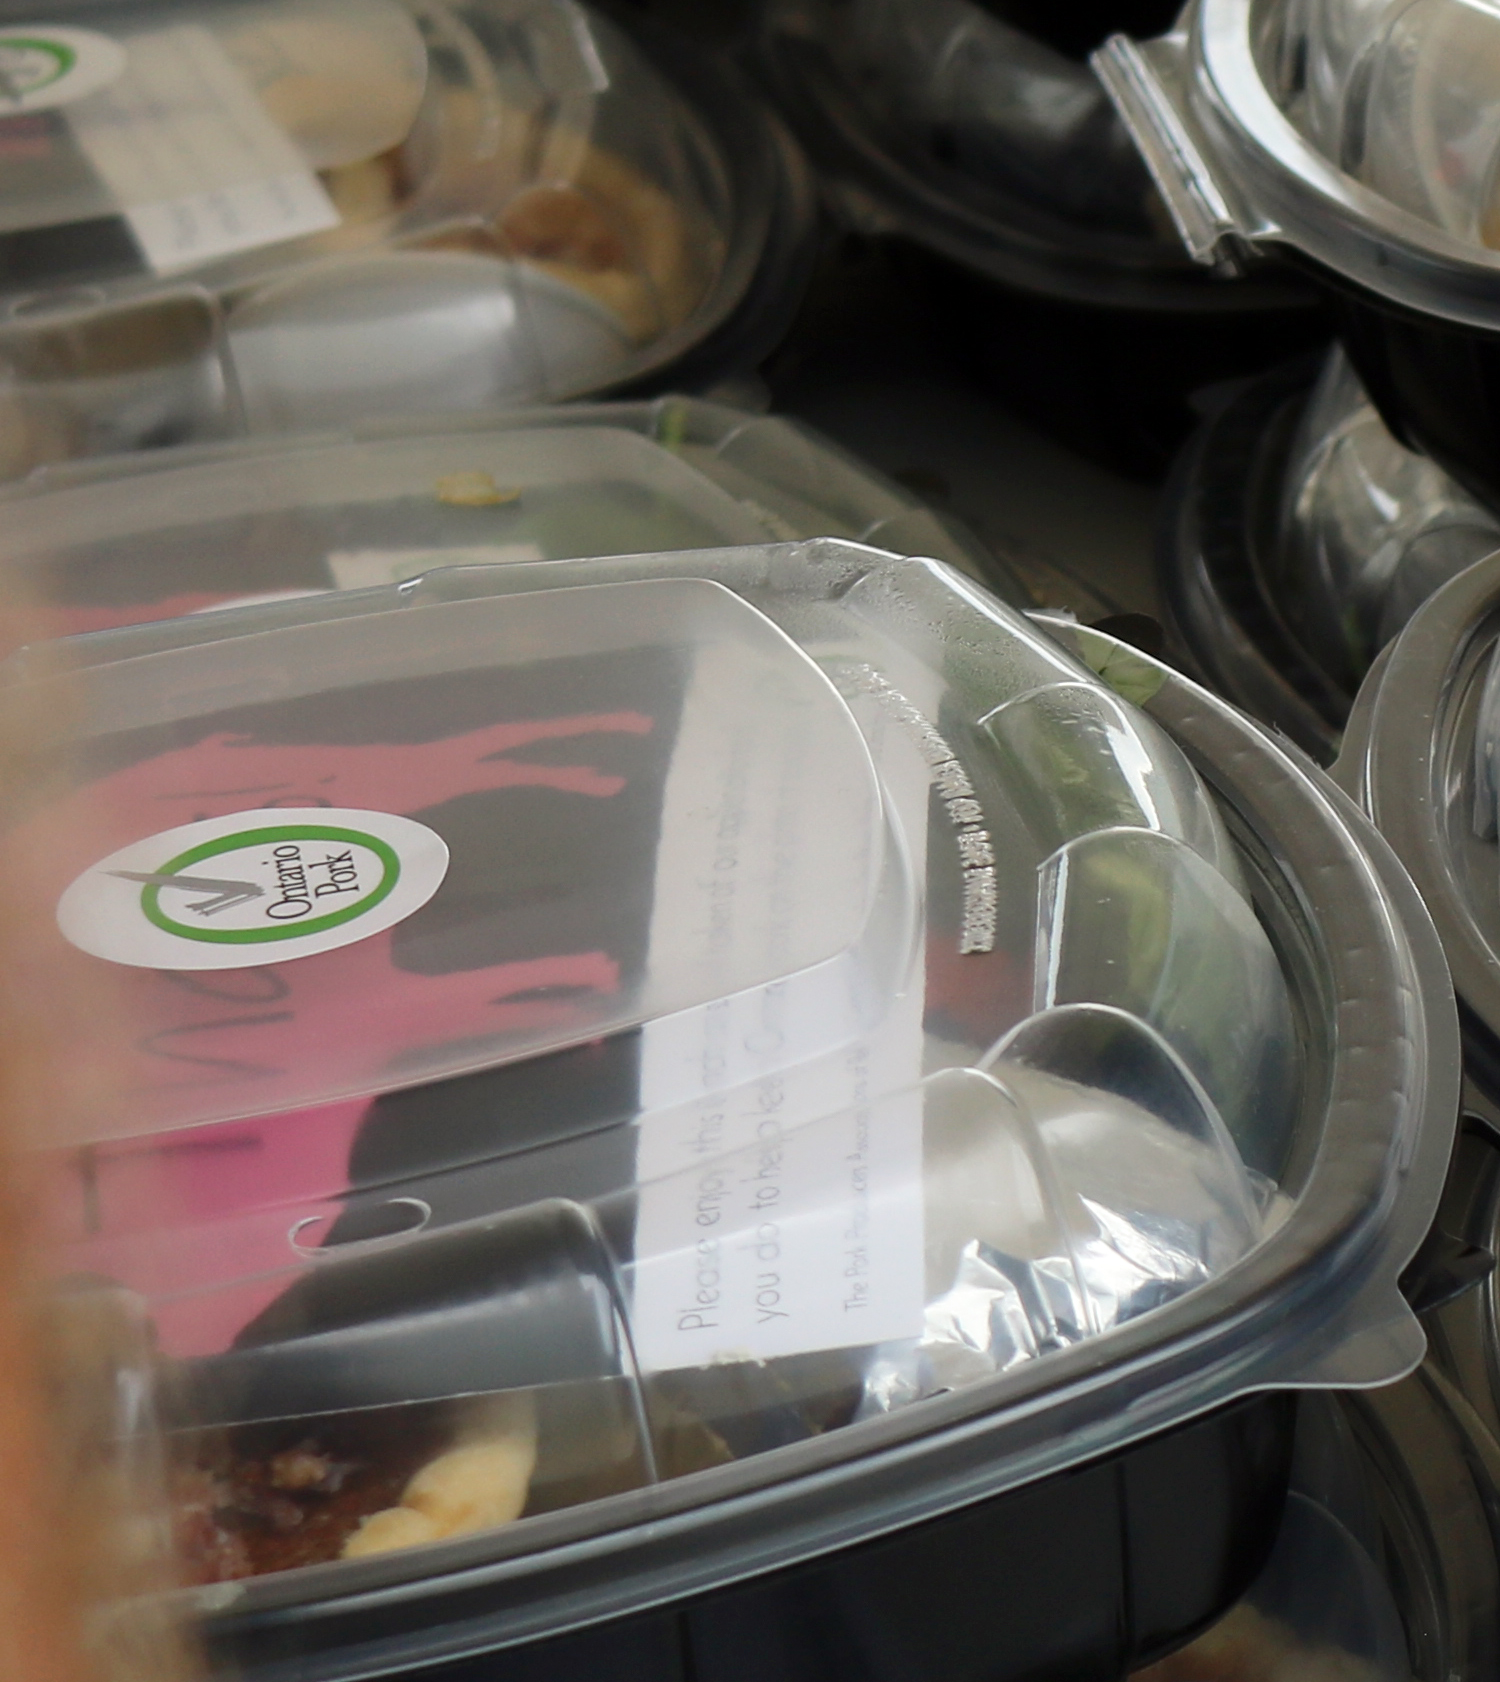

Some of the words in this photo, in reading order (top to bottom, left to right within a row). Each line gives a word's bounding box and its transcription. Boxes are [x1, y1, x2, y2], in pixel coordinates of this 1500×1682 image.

[262, 845, 313, 920] Ontario
[308, 849, 360, 899] Pork
[747, 1184, 781, 1211] to
[737, 1222, 781, 1262] do
[677, 1238, 721, 1331] Please
[755, 1271, 790, 1324] you
